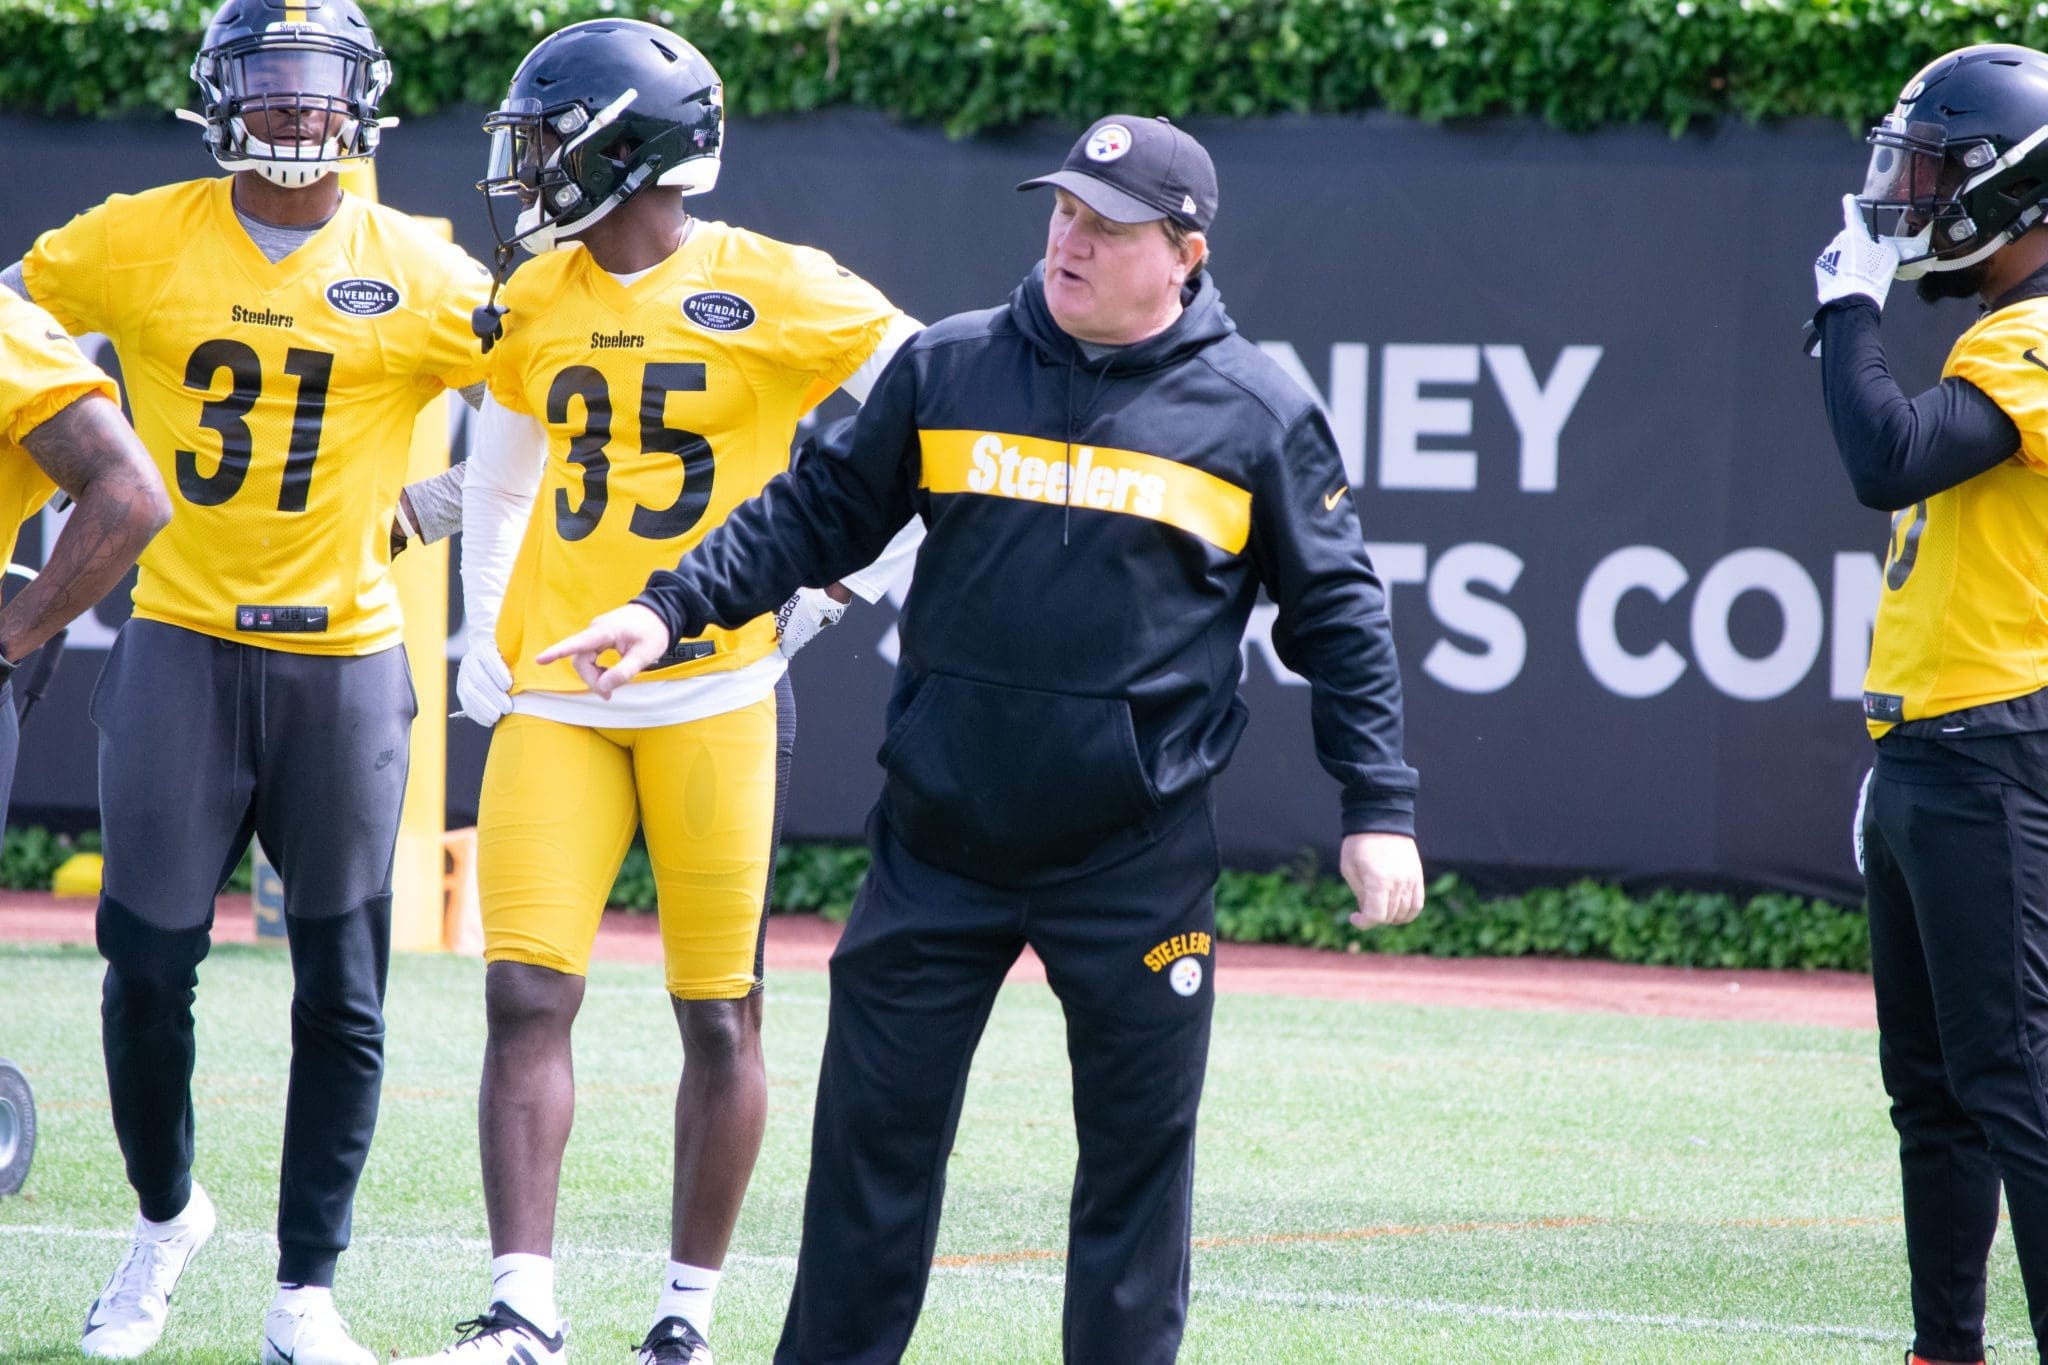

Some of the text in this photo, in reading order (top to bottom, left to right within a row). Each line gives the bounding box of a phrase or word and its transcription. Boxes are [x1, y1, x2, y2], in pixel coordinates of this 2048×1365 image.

[332, 288, 393, 302] RIVENDALE
[689, 300, 750, 320] RIVENDALE
[231, 304, 294, 328] Steelers
[590, 330, 645, 349] Steelers
[175, 339, 334, 512] 31
[546, 362, 716, 541] 35
[967, 434, 1167, 516] Steelers
[1143, 931, 1212, 973] STEELERS
